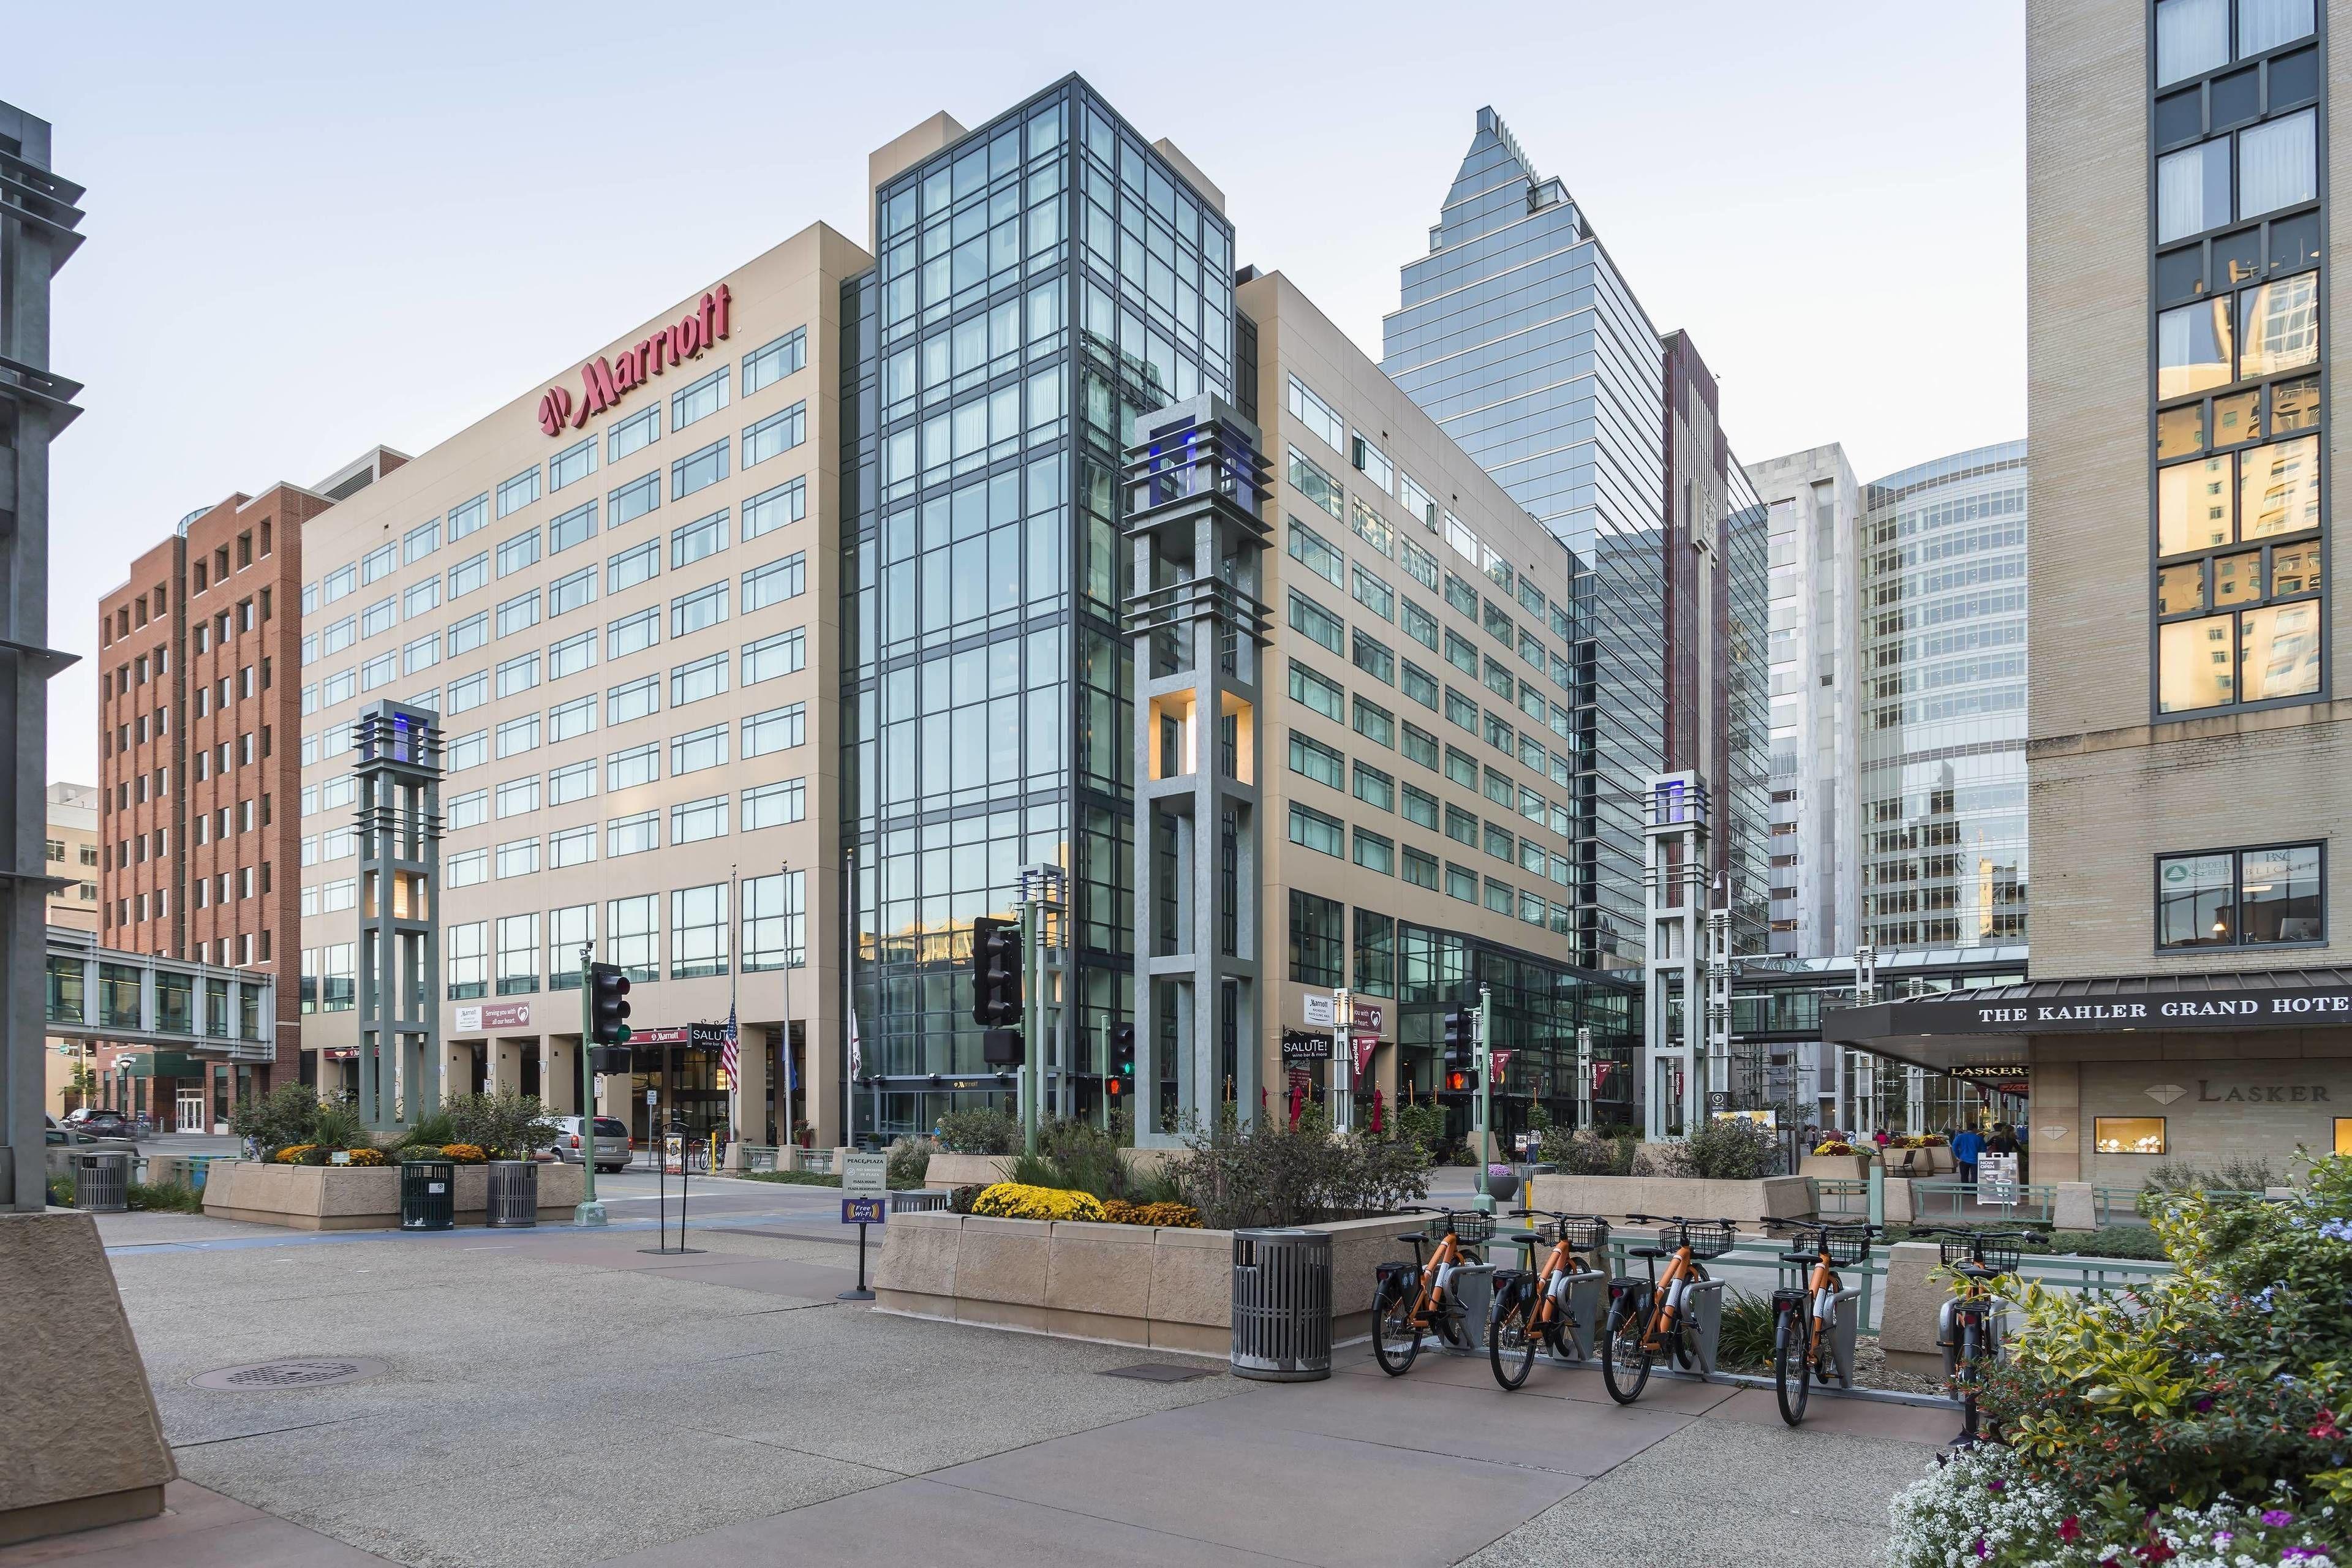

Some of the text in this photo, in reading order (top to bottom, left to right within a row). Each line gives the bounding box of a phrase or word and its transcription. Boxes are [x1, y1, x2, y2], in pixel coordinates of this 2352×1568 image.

[571, 283, 731, 429] Marriott
[2188, 861, 2230, 870] WADDELL
[1310, 999, 1328, 1008] Marriott
[1978, 997, 2352, 1022] THE KAHLER GRAND HOTE
[657, 1032, 679, 1041] Marriott
[693, 1030, 728, 1041] SALUT
[1284, 1040, 1327, 1052] SALUTE!
[1352, 1039, 1361, 1074] peaceplaza
